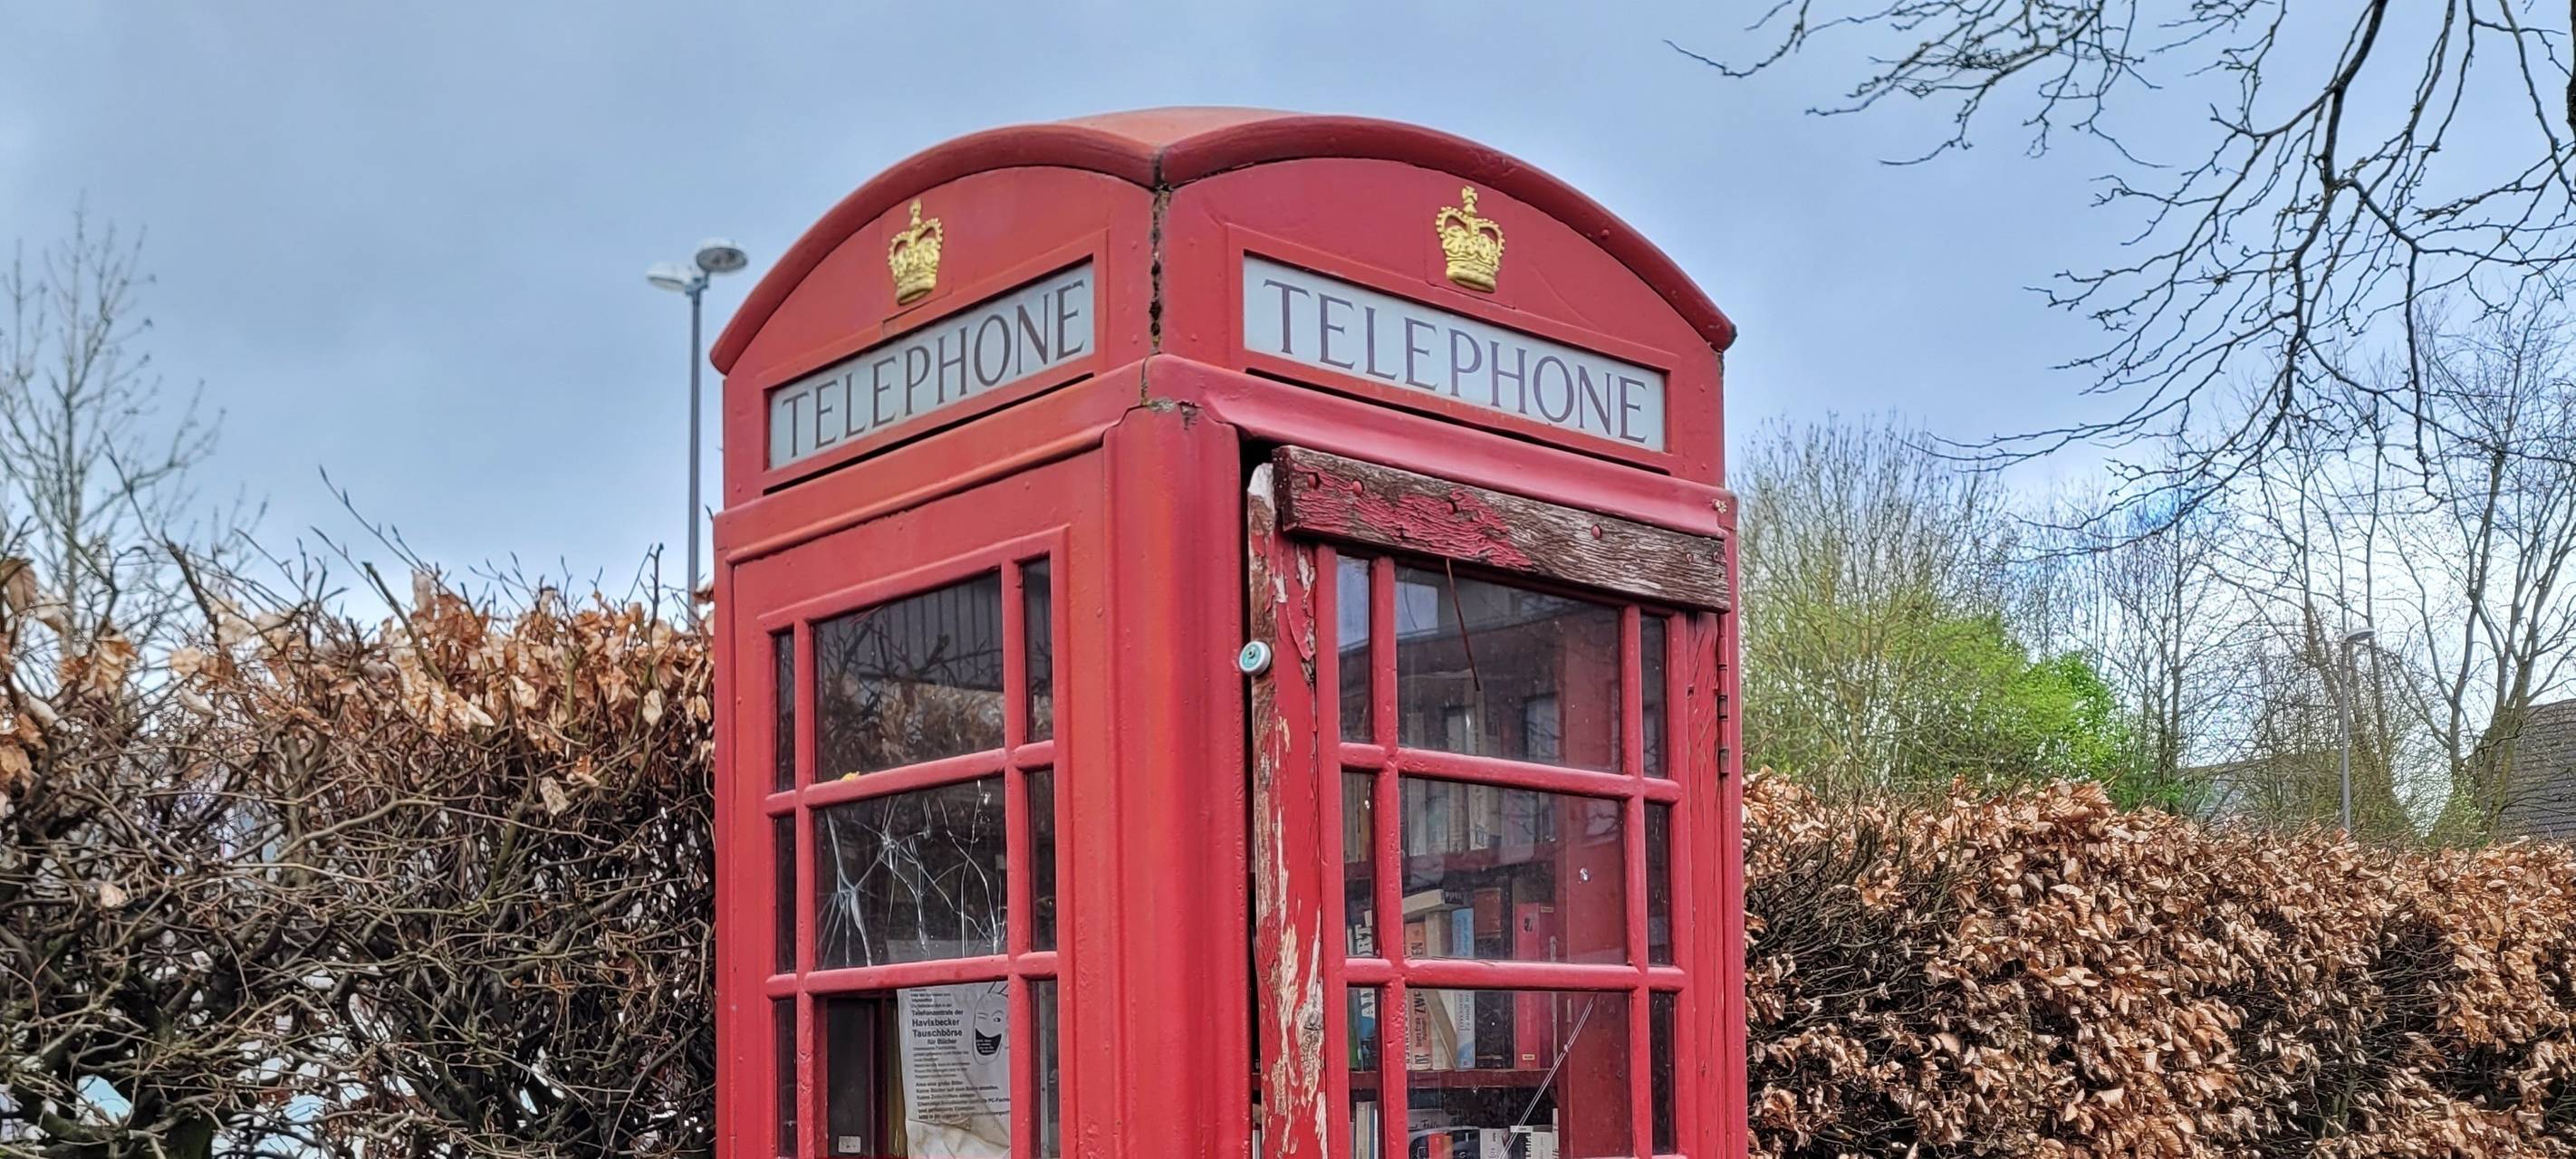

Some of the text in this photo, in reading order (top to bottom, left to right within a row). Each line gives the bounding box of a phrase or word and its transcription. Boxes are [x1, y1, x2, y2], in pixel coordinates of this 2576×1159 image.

[782, 279, 1085, 457] TELEPHONE
[1264, 279, 1648, 444] TELEPHONE
[912, 1018, 960, 1027] Havixbecker
[912, 1029, 963, 1038] Tauschbörse
